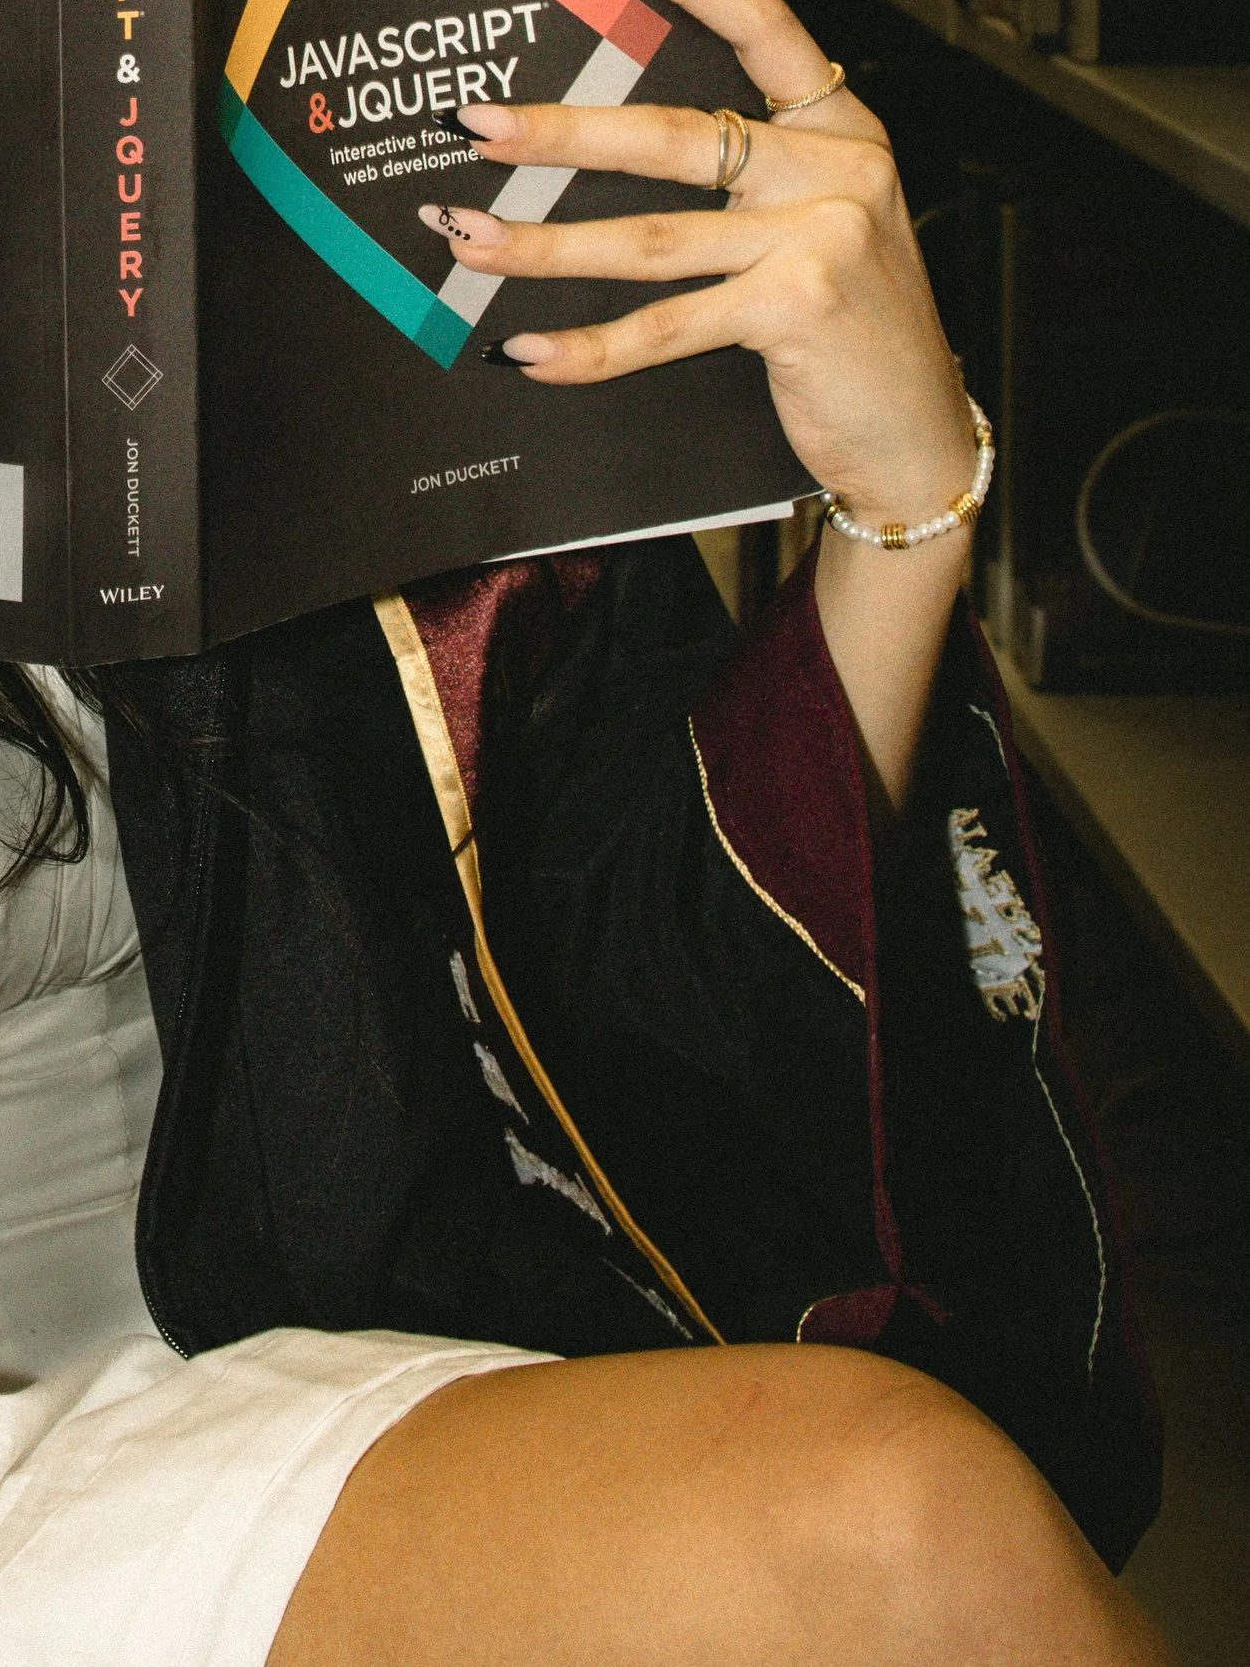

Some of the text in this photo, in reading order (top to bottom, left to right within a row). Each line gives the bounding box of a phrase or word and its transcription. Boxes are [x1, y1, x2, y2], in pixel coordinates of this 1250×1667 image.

[116, 54, 140, 84] &
[308, 57, 520, 134] & JQUERY
[330, 135, 416, 166] interactive
[344, 146, 484, 186] web developme
[116, 97, 144, 318] JQUERY
[411, 456, 520, 494] JON DUCKETT
[126, 438, 140, 558] JON DUCKETT
[100, 585, 165, 605] WILEY
